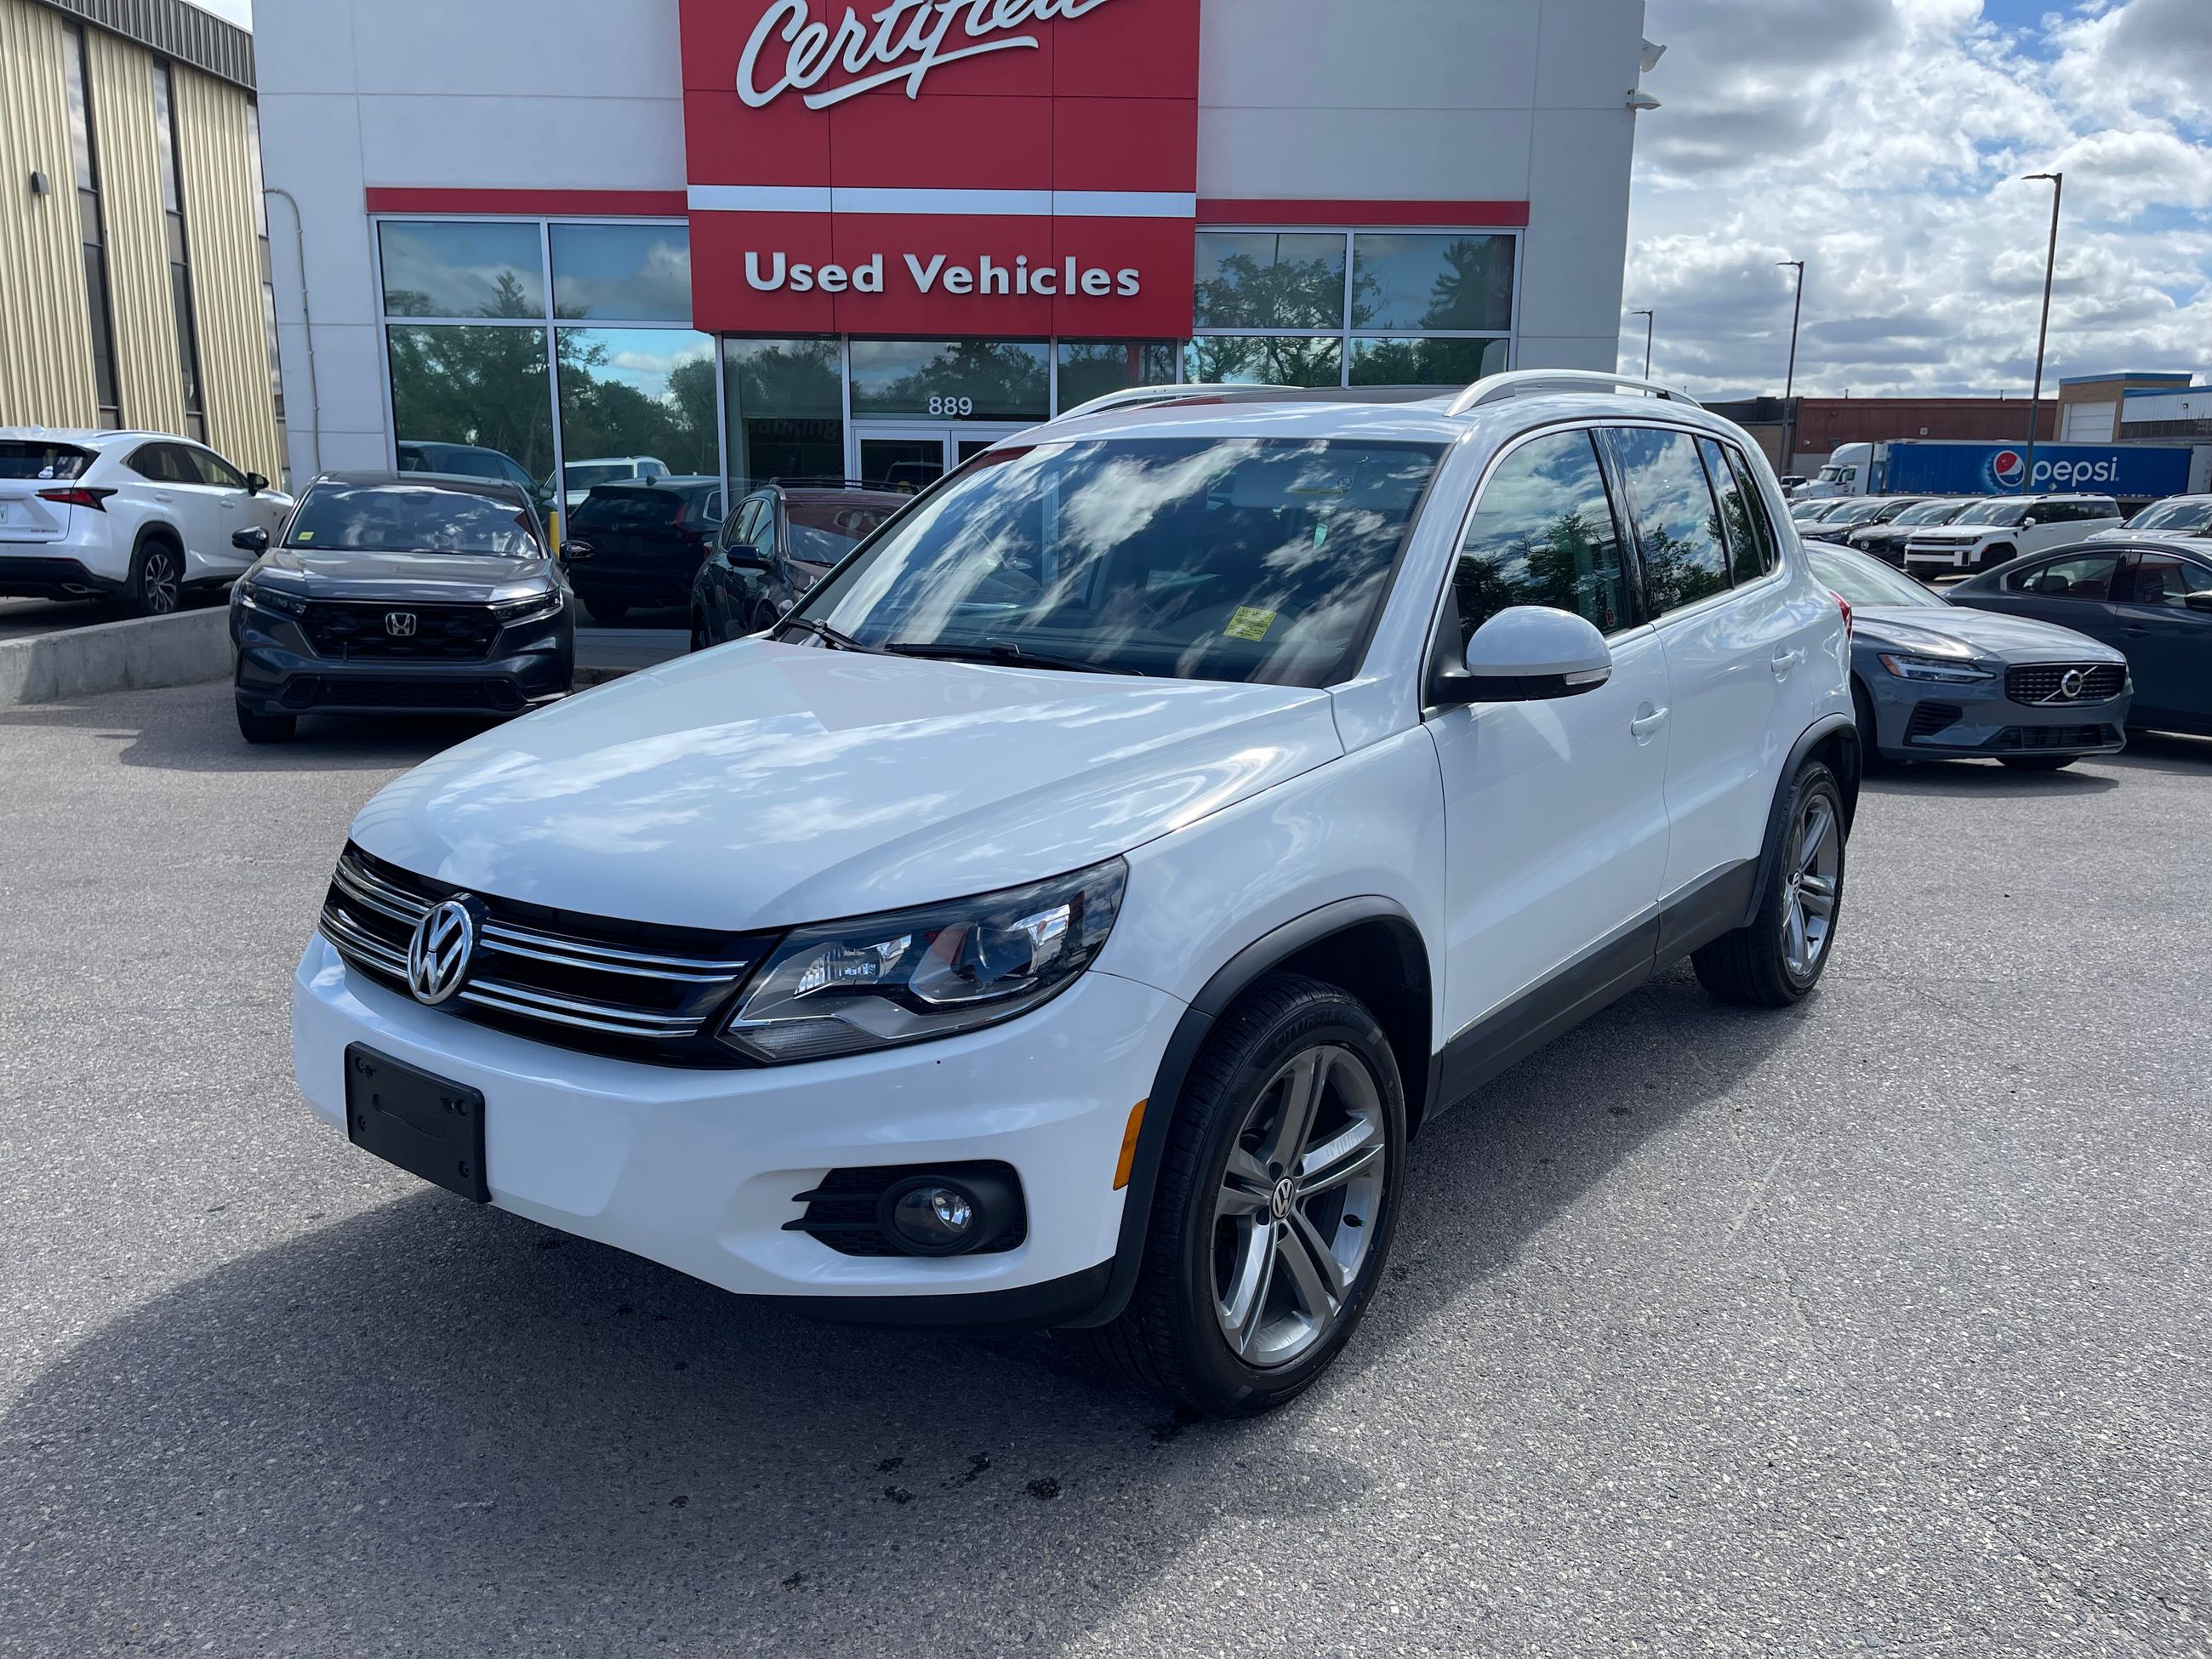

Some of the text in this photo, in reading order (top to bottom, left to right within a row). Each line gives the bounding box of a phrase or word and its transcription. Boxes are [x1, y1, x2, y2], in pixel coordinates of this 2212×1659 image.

[736, 0, 1109, 108] Certif
[744, 252, 1140, 296] Used Vehicles
[928, 396, 973, 416] 889
[2030, 456, 2118, 487] pepsi
